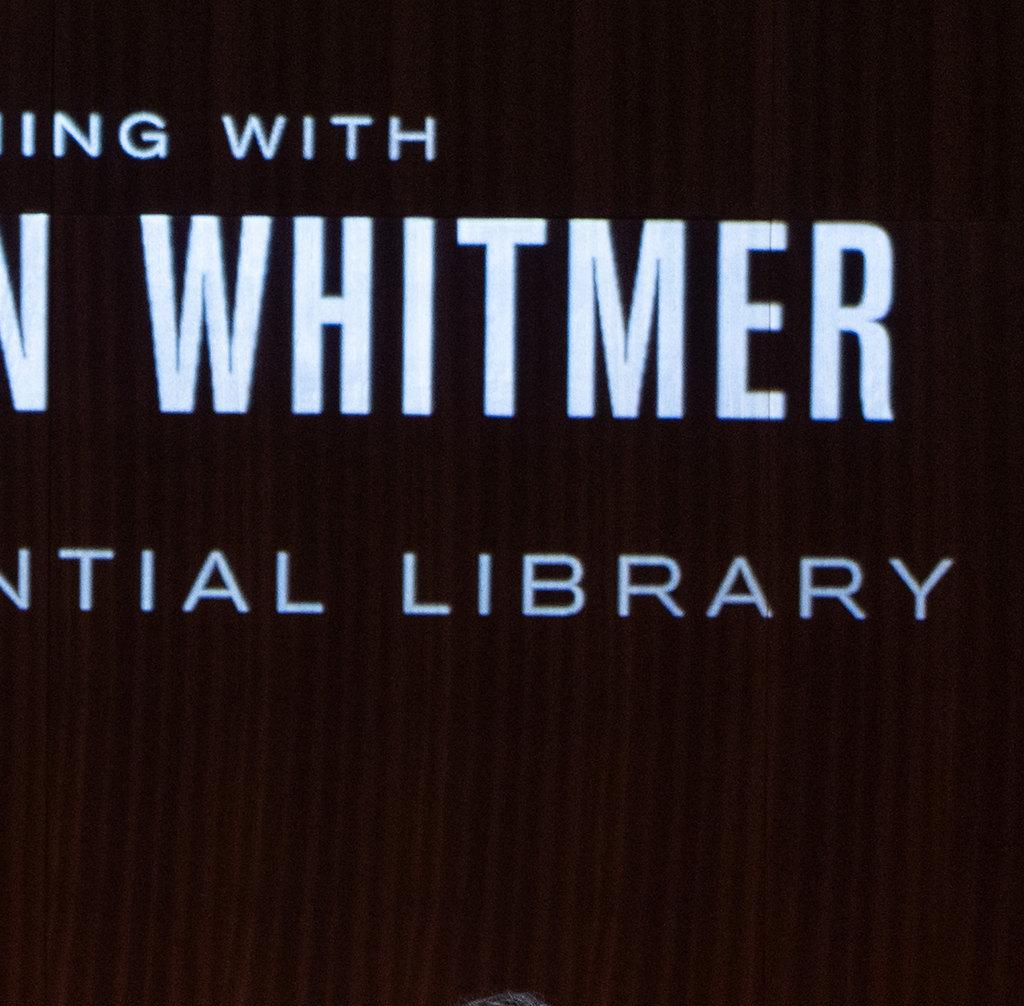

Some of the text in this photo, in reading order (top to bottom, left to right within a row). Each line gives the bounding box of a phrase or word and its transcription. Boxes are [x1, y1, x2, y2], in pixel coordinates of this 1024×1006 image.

[221, 114, 437, 161] WITH
[139, 213, 895, 423] WHITMER
[402, 552, 954, 621] LIBRARY
